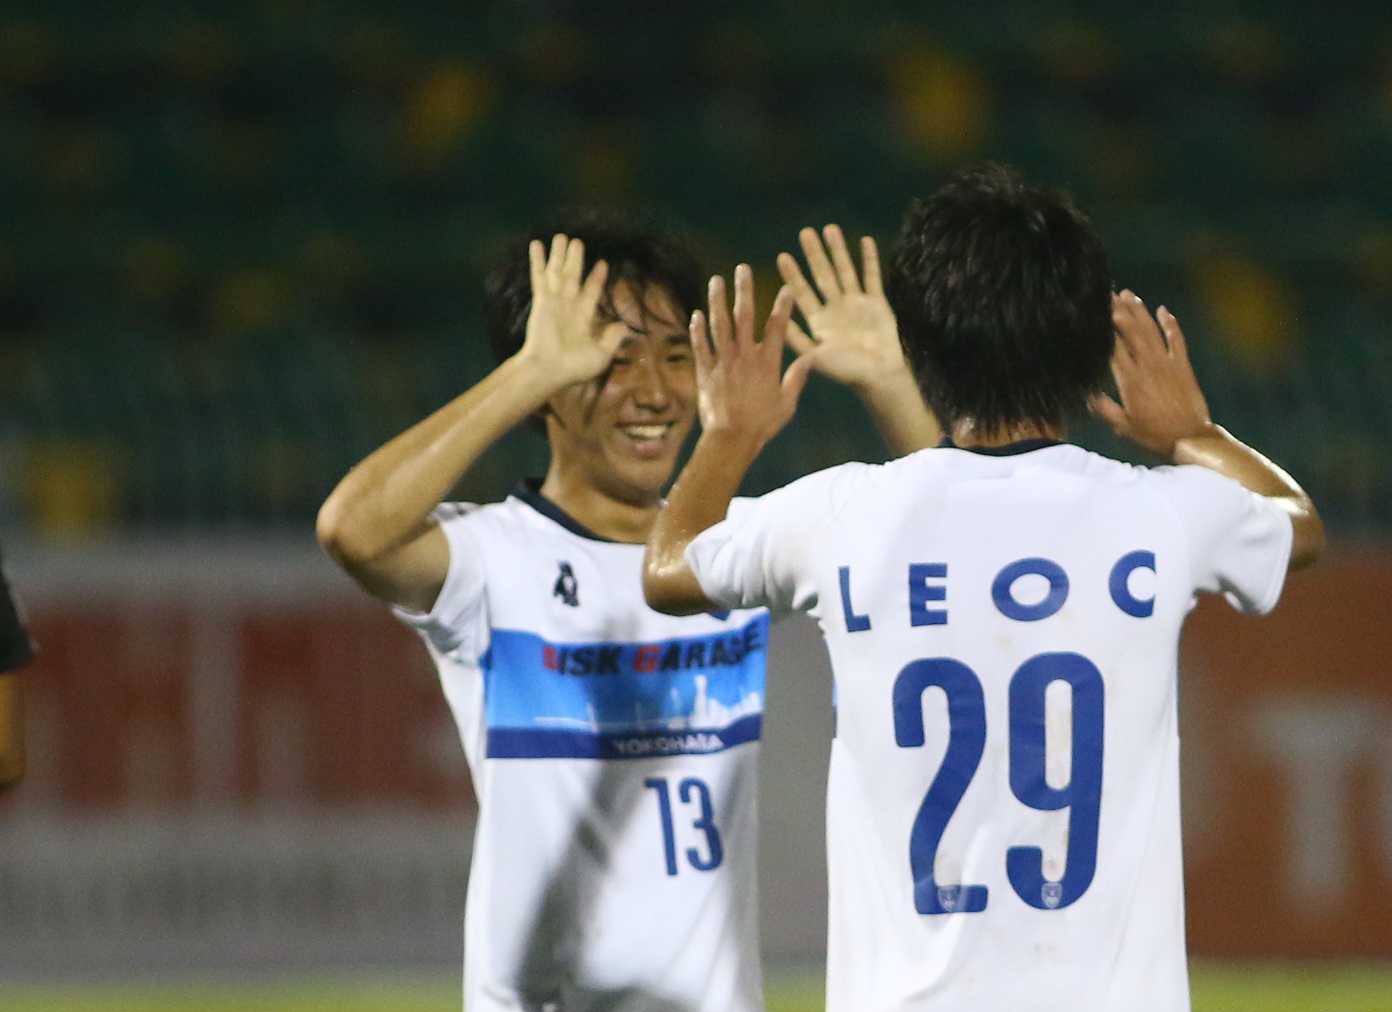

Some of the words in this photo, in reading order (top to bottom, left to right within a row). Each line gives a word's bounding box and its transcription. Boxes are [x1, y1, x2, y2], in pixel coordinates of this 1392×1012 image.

[837, 549, 1158, 632] LEOC
[643, 776, 725, 877] 13
[891, 651, 1105, 915] 29
